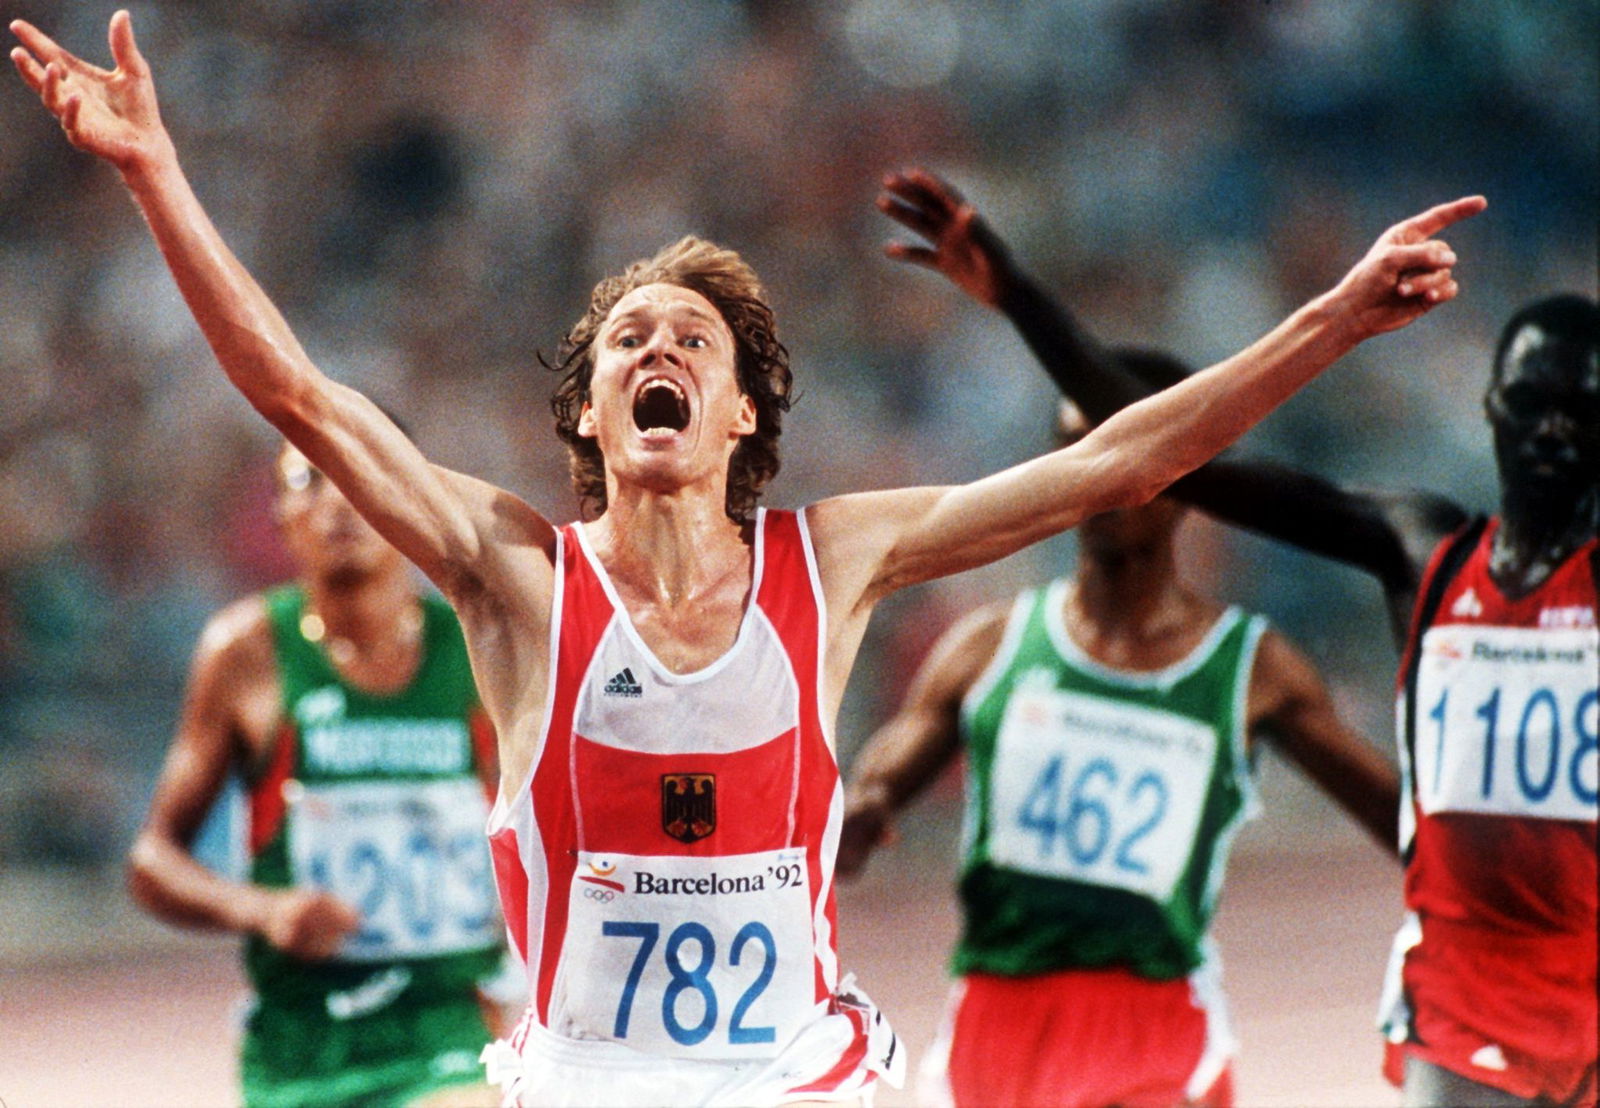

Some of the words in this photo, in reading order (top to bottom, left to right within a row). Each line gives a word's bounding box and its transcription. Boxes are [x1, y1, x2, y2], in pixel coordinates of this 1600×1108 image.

[604, 682, 642, 693] adidas
[1428, 685, 1598, 805] 1108
[1018, 757, 1170, 876] 462
[602, 921, 778, 1046] 782
